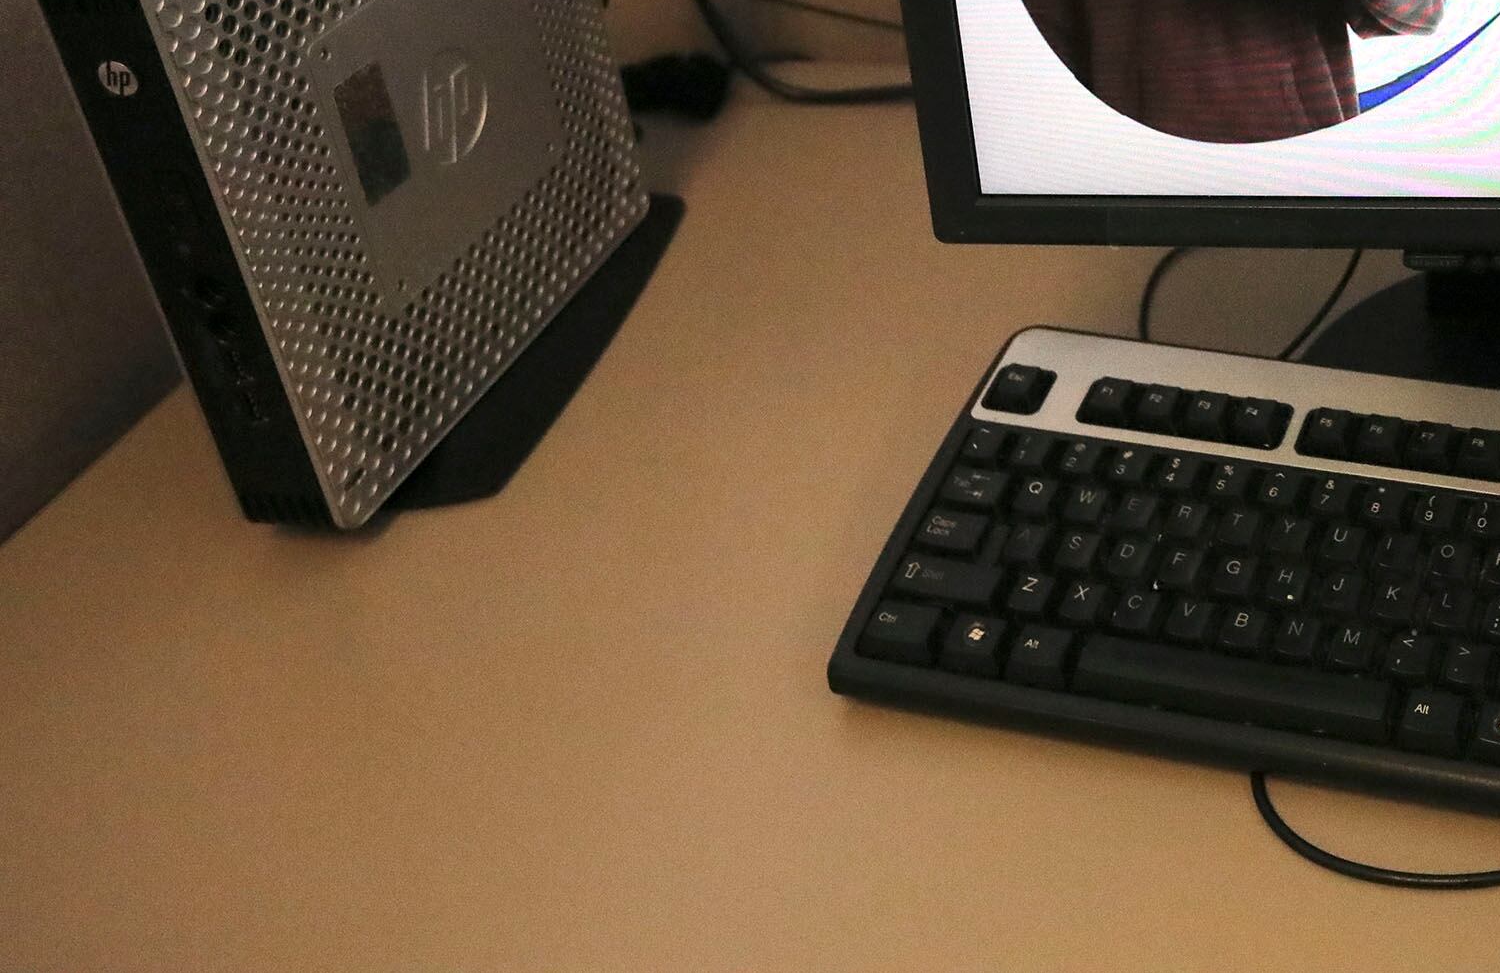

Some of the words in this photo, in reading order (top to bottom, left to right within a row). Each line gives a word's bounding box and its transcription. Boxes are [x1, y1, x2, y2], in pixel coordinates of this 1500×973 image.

[101, 60, 135, 97] hp
[1028, 481, 1044, 495] Q
[1215, 479, 1227, 491] 5
[1268, 486, 1279, 498] 6
[1079, 490, 1097, 504] W
[1127, 498, 1140, 511] E
[1320, 494, 1330, 505] 7
[1178, 505, 1192, 519] R
[1370, 502, 1381, 513] 8
[1232, 513, 1244, 526] T
[1424, 510, 1434, 522] 9
[1284, 518, 1296, 534] Y
[1333, 527, 1348, 542] U
[1069, 535, 1083, 550] S
[1119, 544, 1135, 559] D
[1172, 552, 1188, 566] F
[1226, 560, 1242, 575] G
[1277, 569, 1294, 584] H
[1021, 577, 1039, 593] Z
[1073, 584, 1091, 601] X
[1332, 578, 1345, 592] J
[1385, 586, 1401, 601] K
[1441, 593, 1452, 608] L
[1127, 594, 1144, 610] C
[1183, 603, 1197, 618] V
[1234, 612, 1249, 628] B
[1287, 620, 1304, 636] N
[1024, 638, 1040, 649] Alt
[1343, 628, 1361, 646] M
[1414, 703, 1430, 715] Alt
